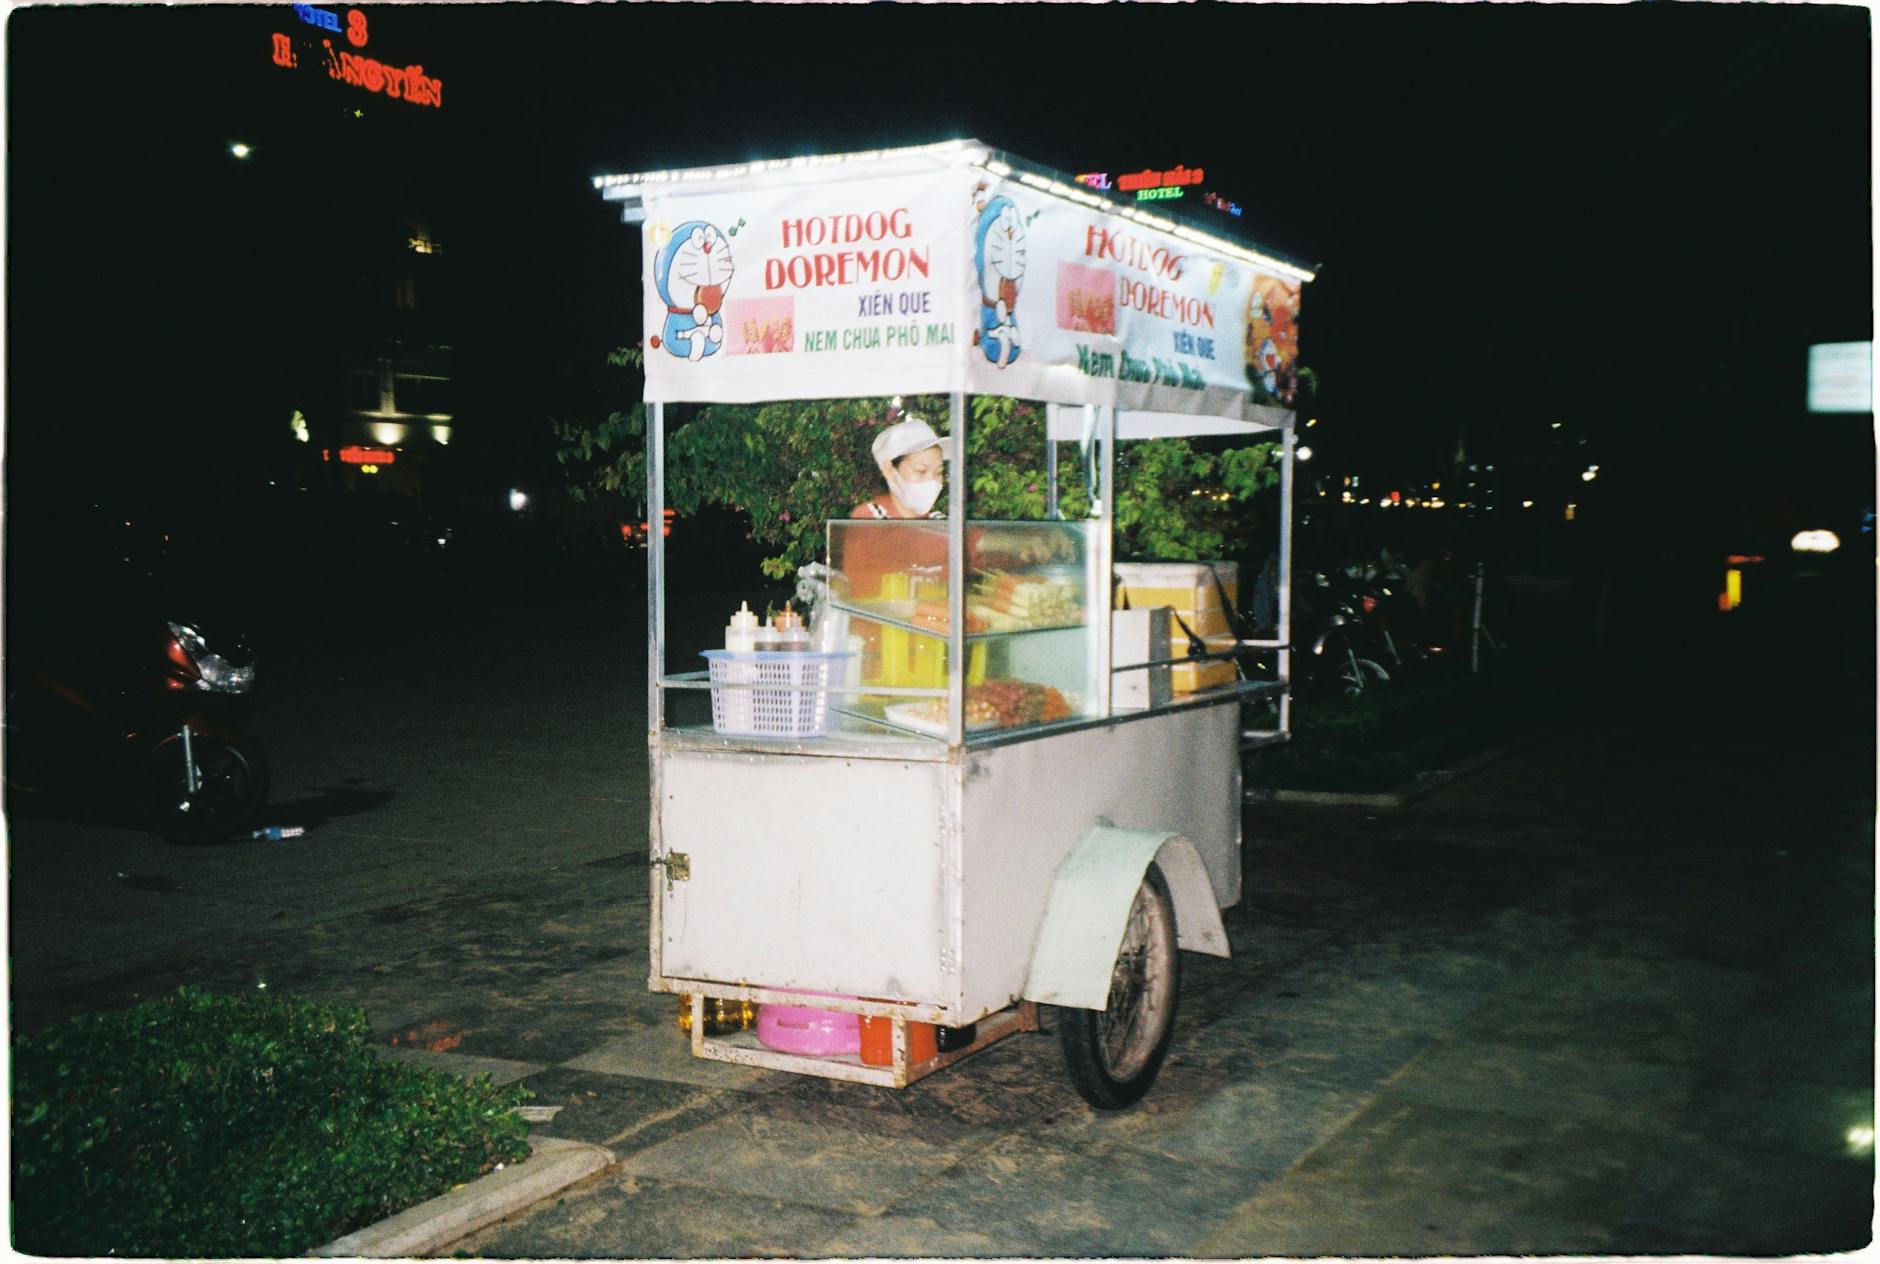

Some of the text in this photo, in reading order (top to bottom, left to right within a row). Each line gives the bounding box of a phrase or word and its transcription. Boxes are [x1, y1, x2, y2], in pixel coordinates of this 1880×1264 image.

[348, 9, 368, 47] 8
[1137, 187, 1184, 201] HOTEL
[782, 208, 912, 249] HOTDOG
[765, 246, 929, 289] DOREMON
[899, 292, 931, 314] QUE
[1120, 276, 1215, 328] DOREMON
[805, 331, 838, 352] NEM
[842, 327, 881, 349] CHUA
[926, 323, 955, 346] MAI
